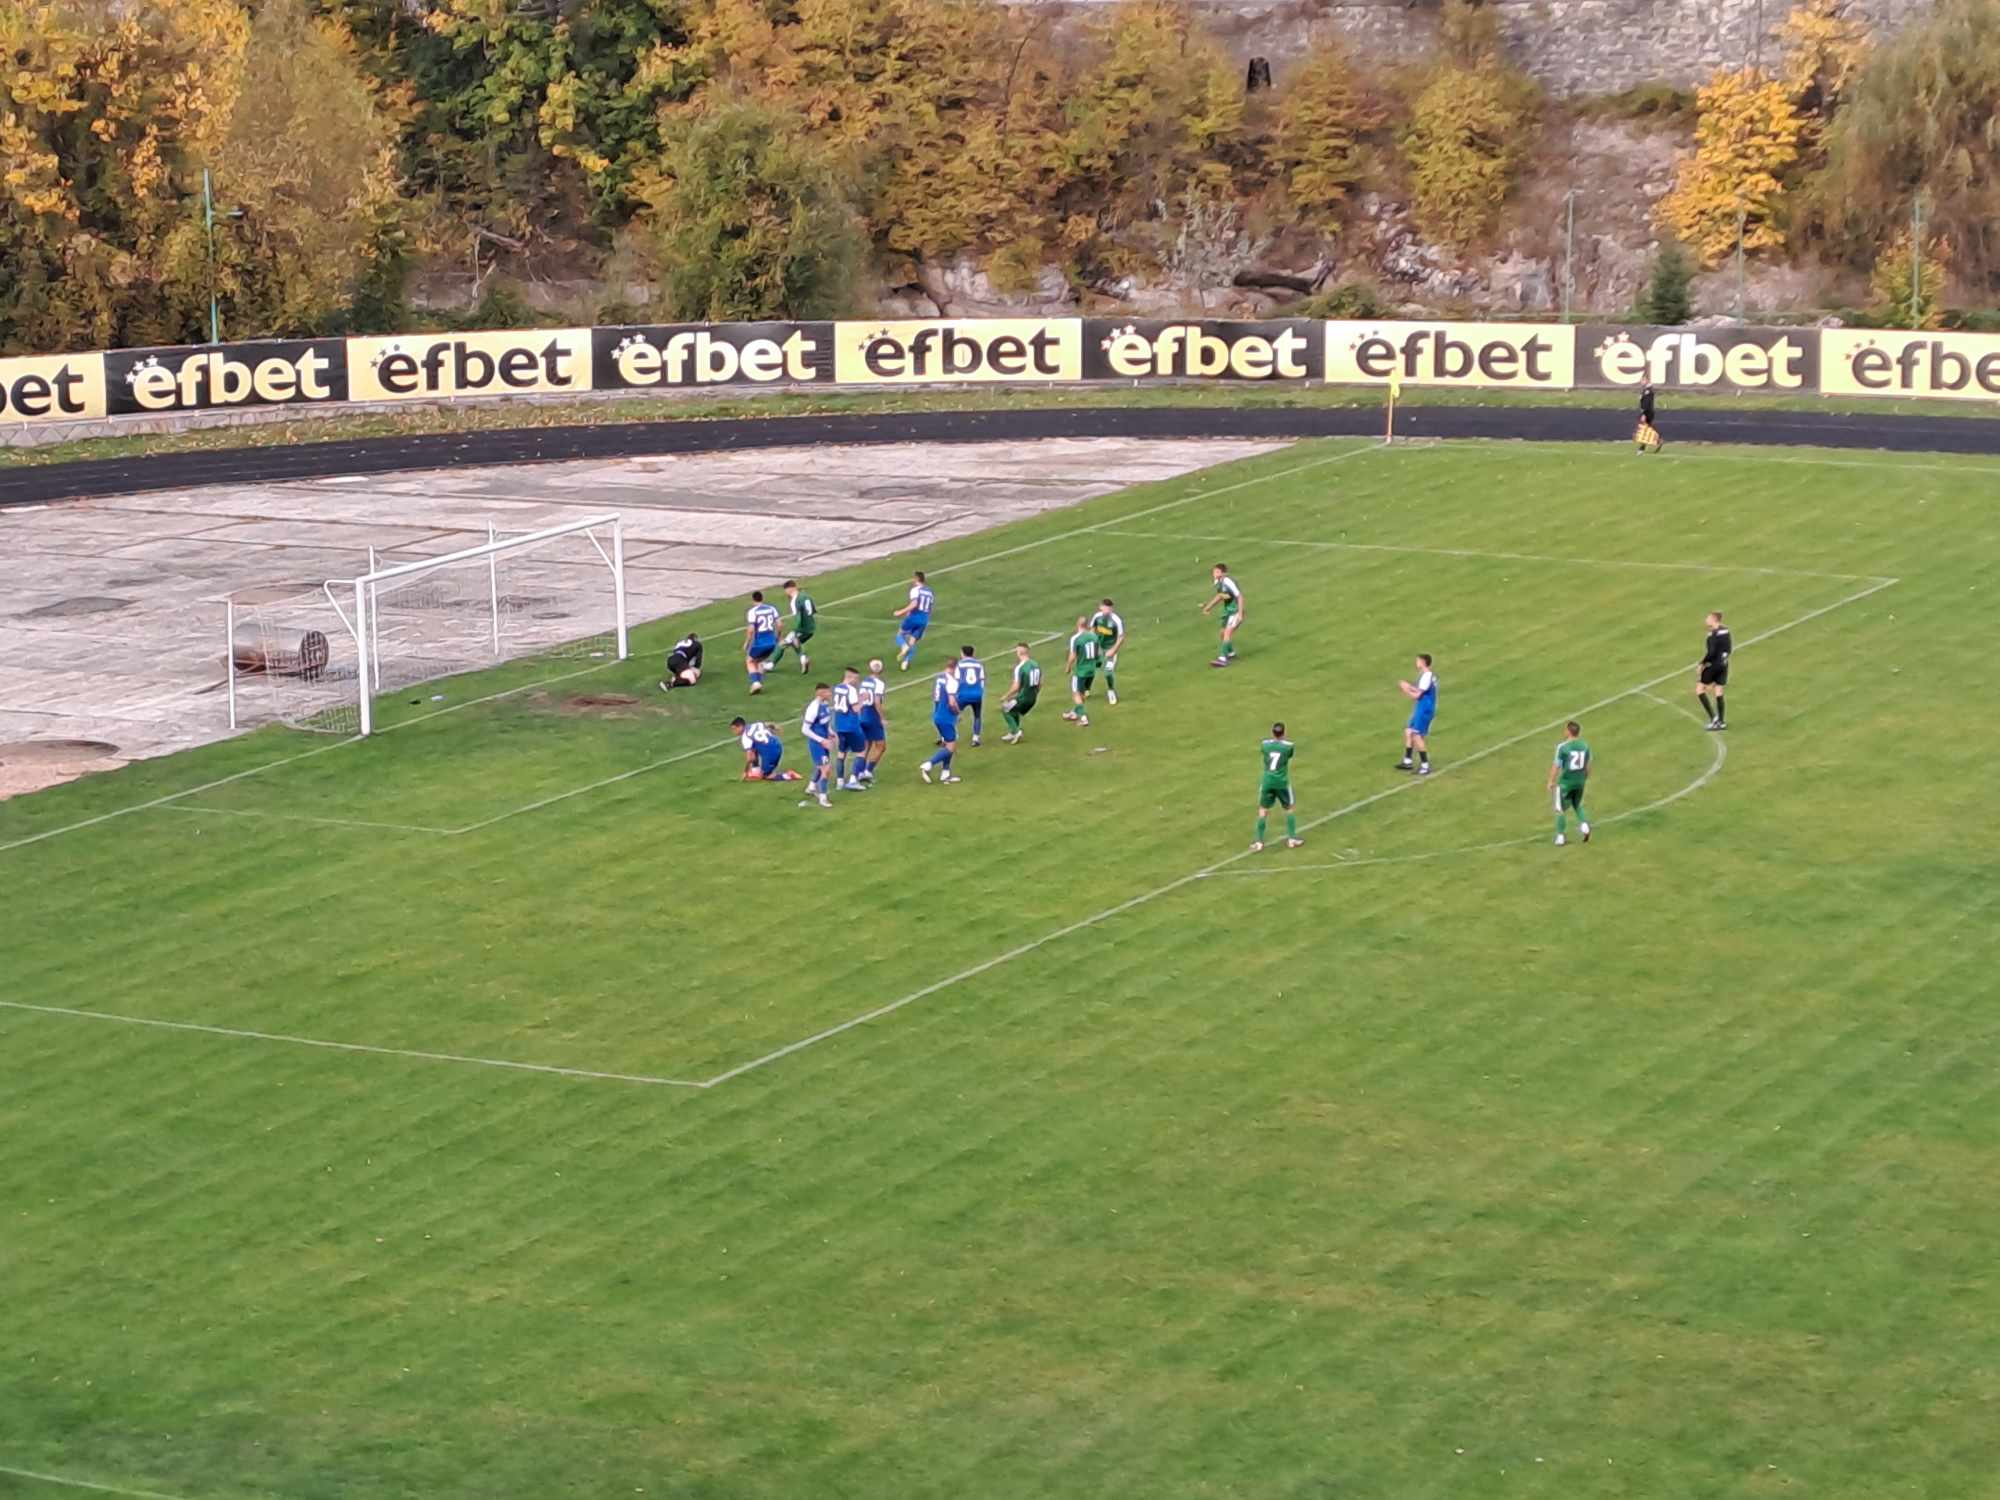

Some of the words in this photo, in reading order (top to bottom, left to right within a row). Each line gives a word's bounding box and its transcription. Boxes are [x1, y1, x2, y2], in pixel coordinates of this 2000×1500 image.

[133, 346, 331, 409] efbet
[378, 339, 574, 393] efbet
[619, 331, 817, 385] efbet
[866, 326, 1062, 376] efbet
[1110, 326, 1308, 379] efbet
[1356, 330, 1552, 381] efbet
[1602, 333, 1803, 388] efbet
[0, 363, 85, 416] et
[757, 615, 774, 632] 28
[1269, 752, 1281, 770] 7
[1569, 751, 1586, 770] 21
